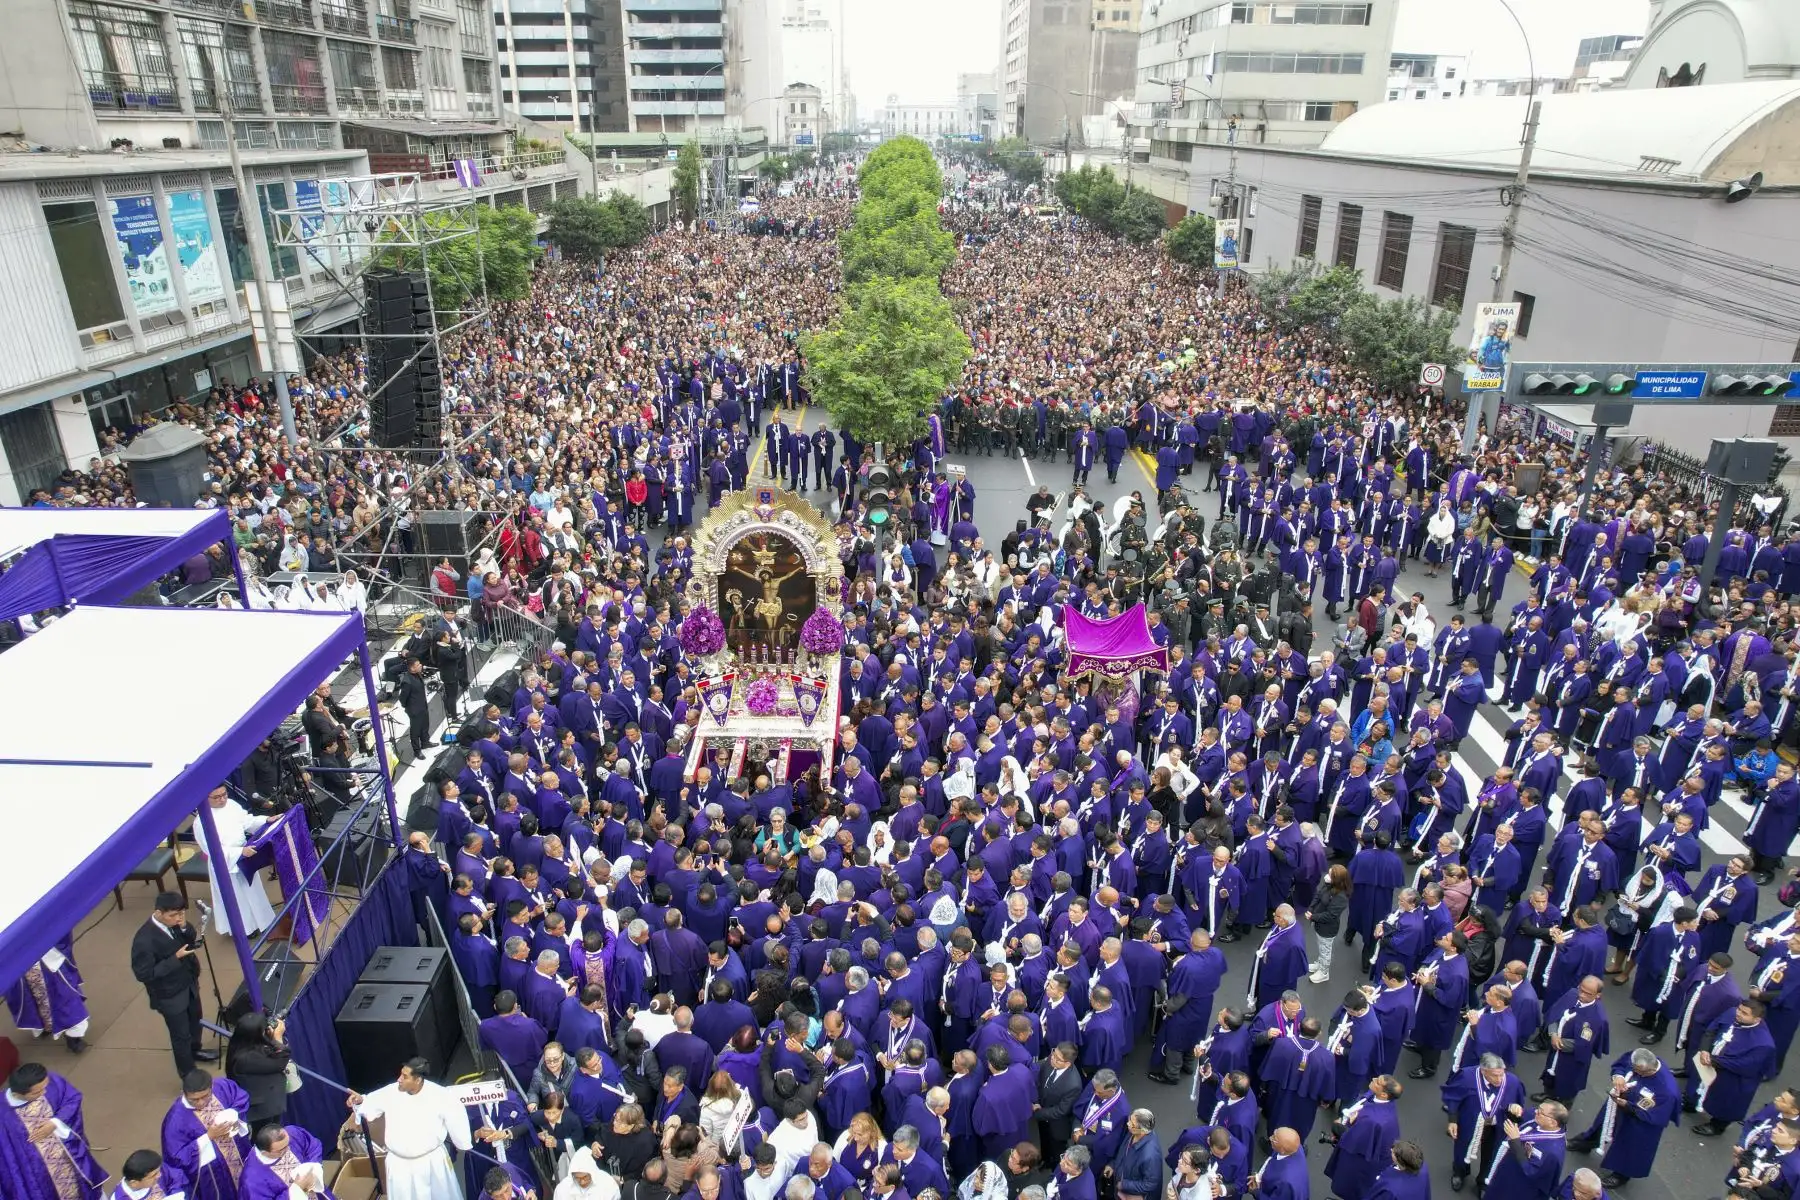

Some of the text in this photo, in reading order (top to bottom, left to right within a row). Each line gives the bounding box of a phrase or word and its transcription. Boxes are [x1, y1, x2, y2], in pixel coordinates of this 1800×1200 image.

[1492, 307, 1514, 316] LIMA
[1427, 368, 1439, 378] 50
[1548, 421, 1560, 432] SAN
[460, 1092, 504, 1104] OMUNION
